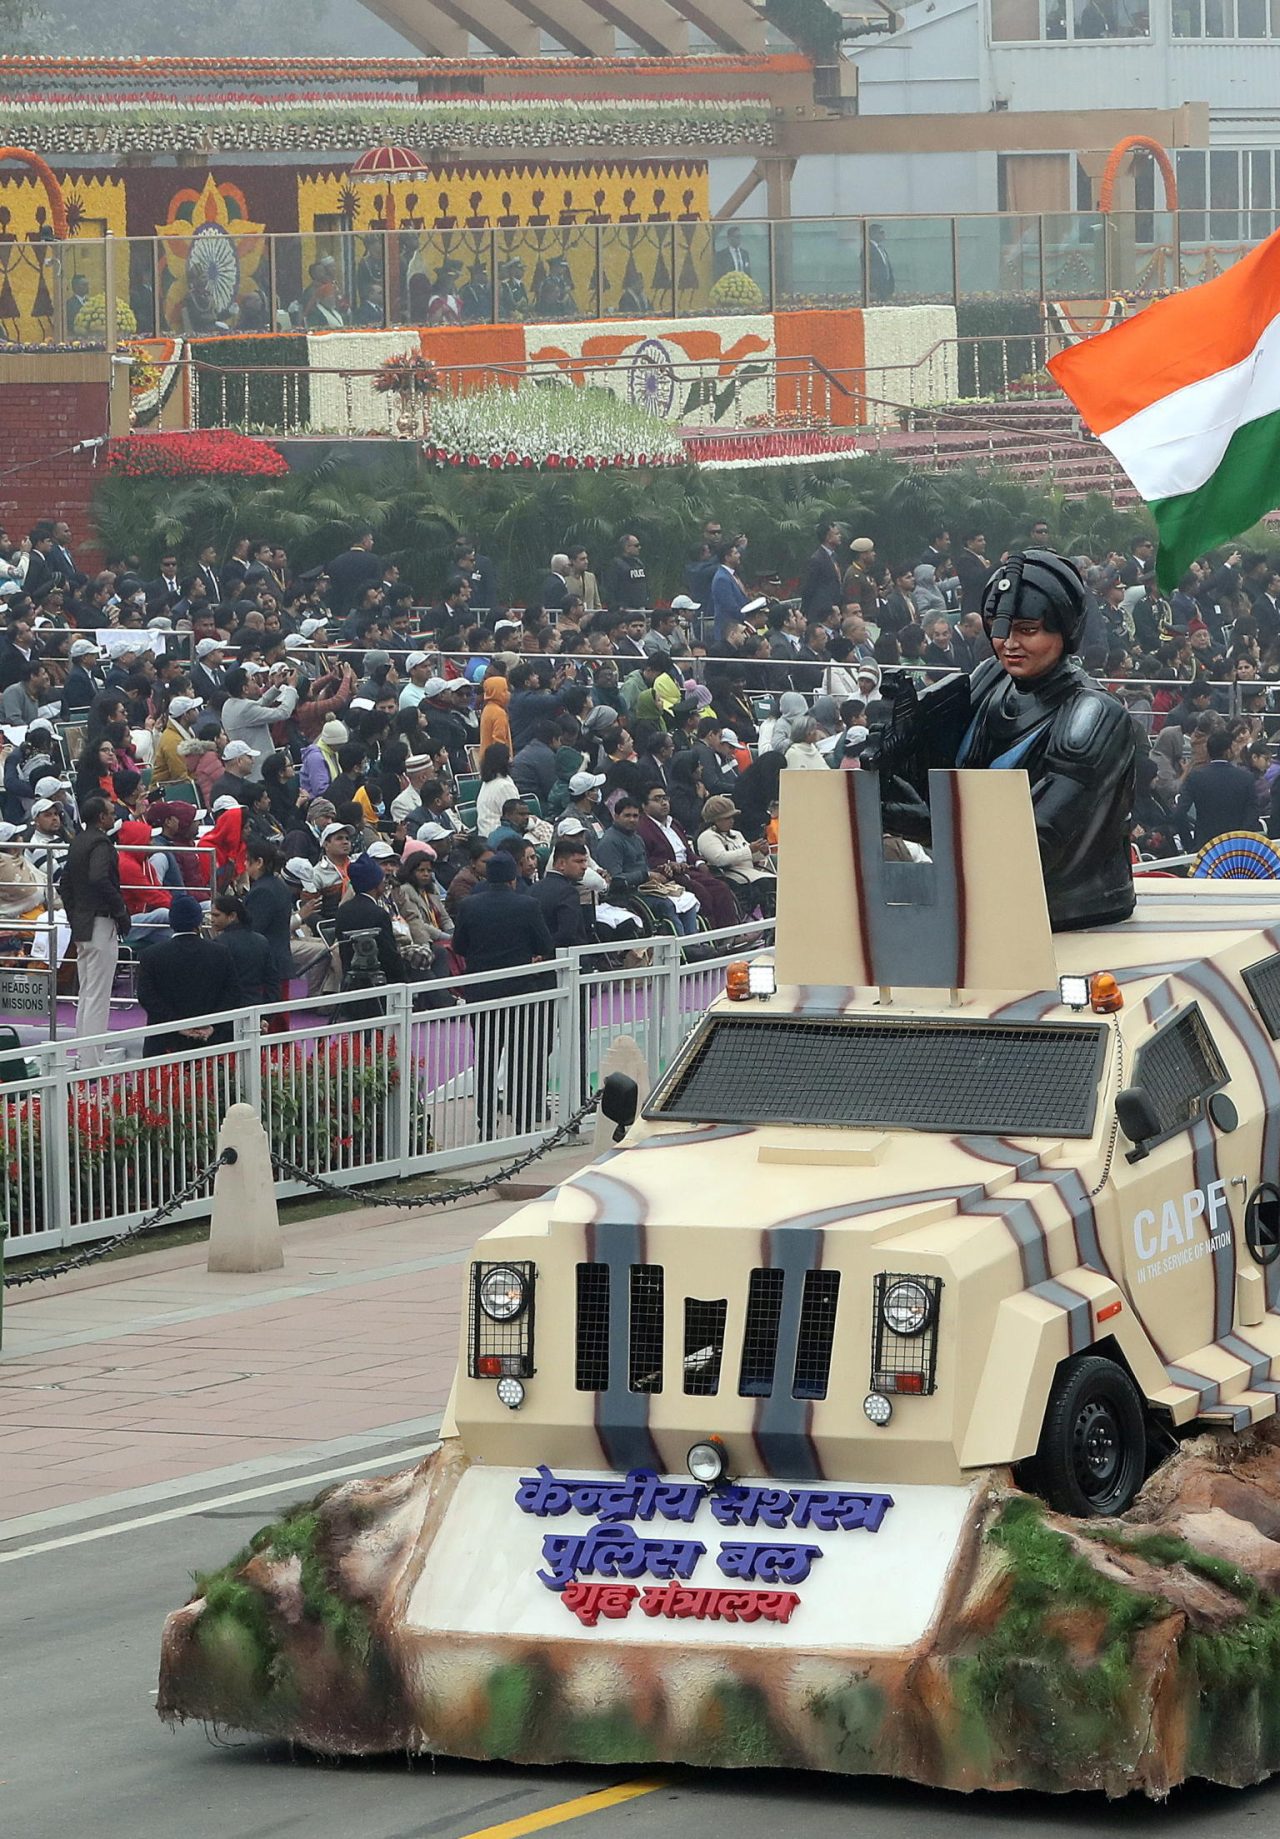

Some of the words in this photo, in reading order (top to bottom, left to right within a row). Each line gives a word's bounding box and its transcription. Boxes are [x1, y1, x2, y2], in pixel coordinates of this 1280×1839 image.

[1, 982, 30, 994] HEADS
[32, 983, 43, 994] OF
[1, 998, 43, 1010] MISSIONS
[1133, 1178, 1227, 1260] CAPF
[1137, 1267, 1146, 1285] IN
[1147, 1262, 1161, 1280] THE
[1163, 1249, 1193, 1273] SERVICE
[1194, 1242, 1204, 1258] OF
[1205, 1230, 1231, 1254] NATION
[514, 1464, 710, 1524] केन्द्रीय
[710, 1485, 895, 1533] सशस्त्र
[536, 1523, 706, 1591] पुलिस
[716, 1541, 824, 1585] बल
[560, 1580, 640, 1626] गृह
[639, 1579, 801, 1624] मंत्रालय
